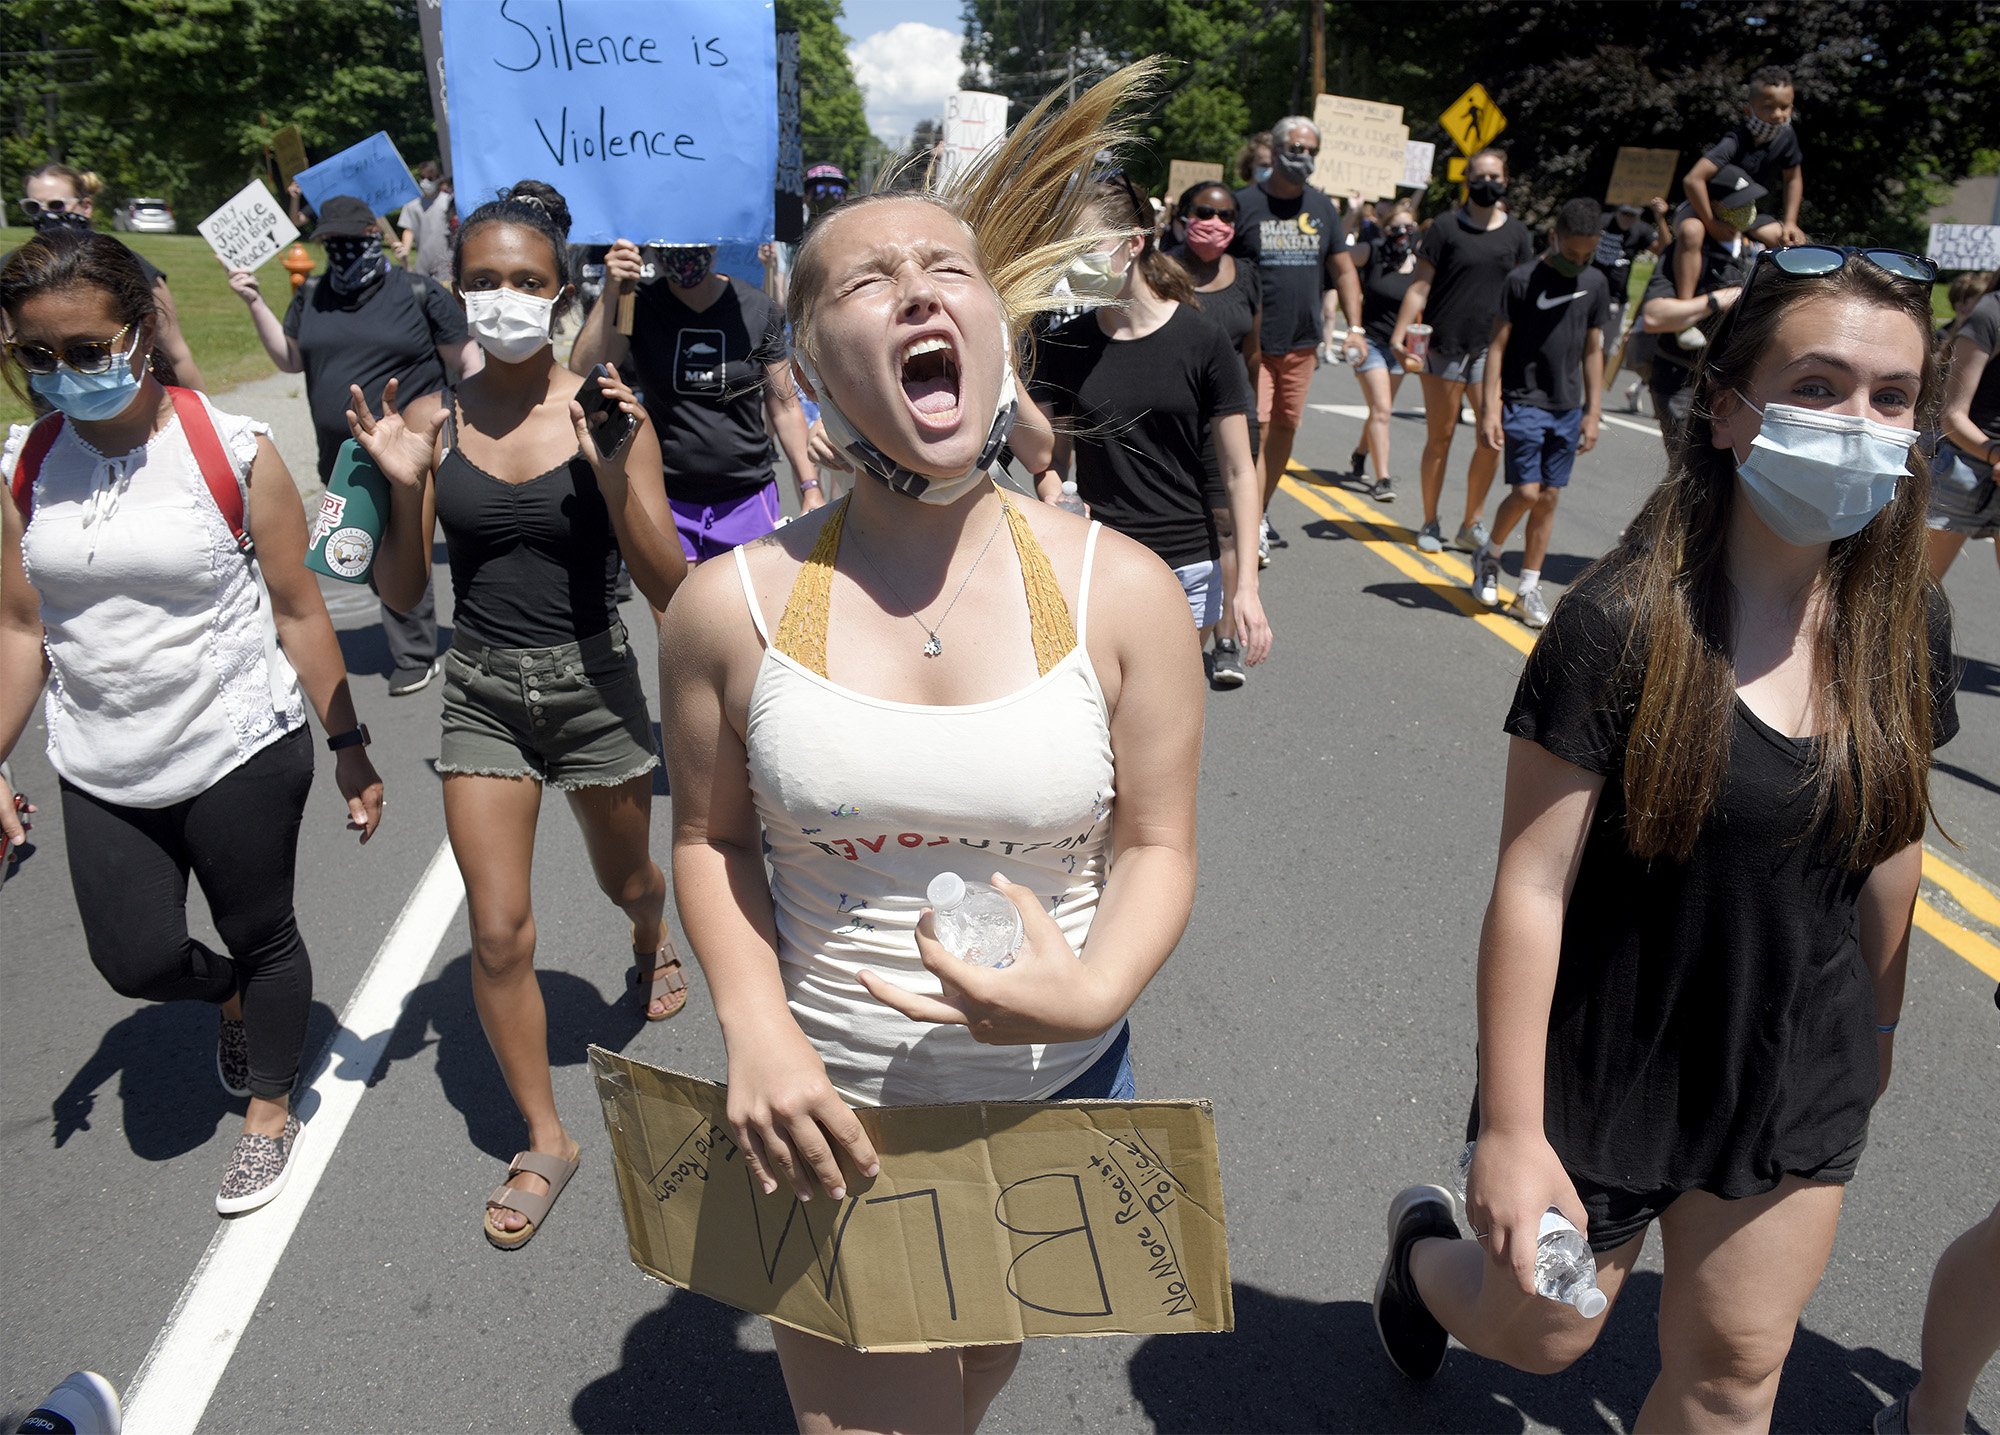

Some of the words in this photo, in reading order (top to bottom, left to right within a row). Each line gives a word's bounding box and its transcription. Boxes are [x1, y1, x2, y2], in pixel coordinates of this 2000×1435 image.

[493, 0, 663, 72] Silence
[691, 35, 729, 67] is
[534, 106, 706, 167] Violence
[1318, 158, 1394, 188] MATTER
[1260, 234, 1321, 250] MONDAY
[1936, 224, 1995, 242] BLACK
[1942, 240, 1996, 259] LIVES
[685, 370, 714, 382] MM
[321, 497, 341, 515] PI
[695, 1125, 738, 1162] End
[655, 1154, 709, 1202] Racism
[1087, 1154, 1141, 1225] Racist
[745, 1164, 1113, 1319] BLM
[1137, 1226, 1177, 1280] More
[1161, 1281, 1193, 1317] No
